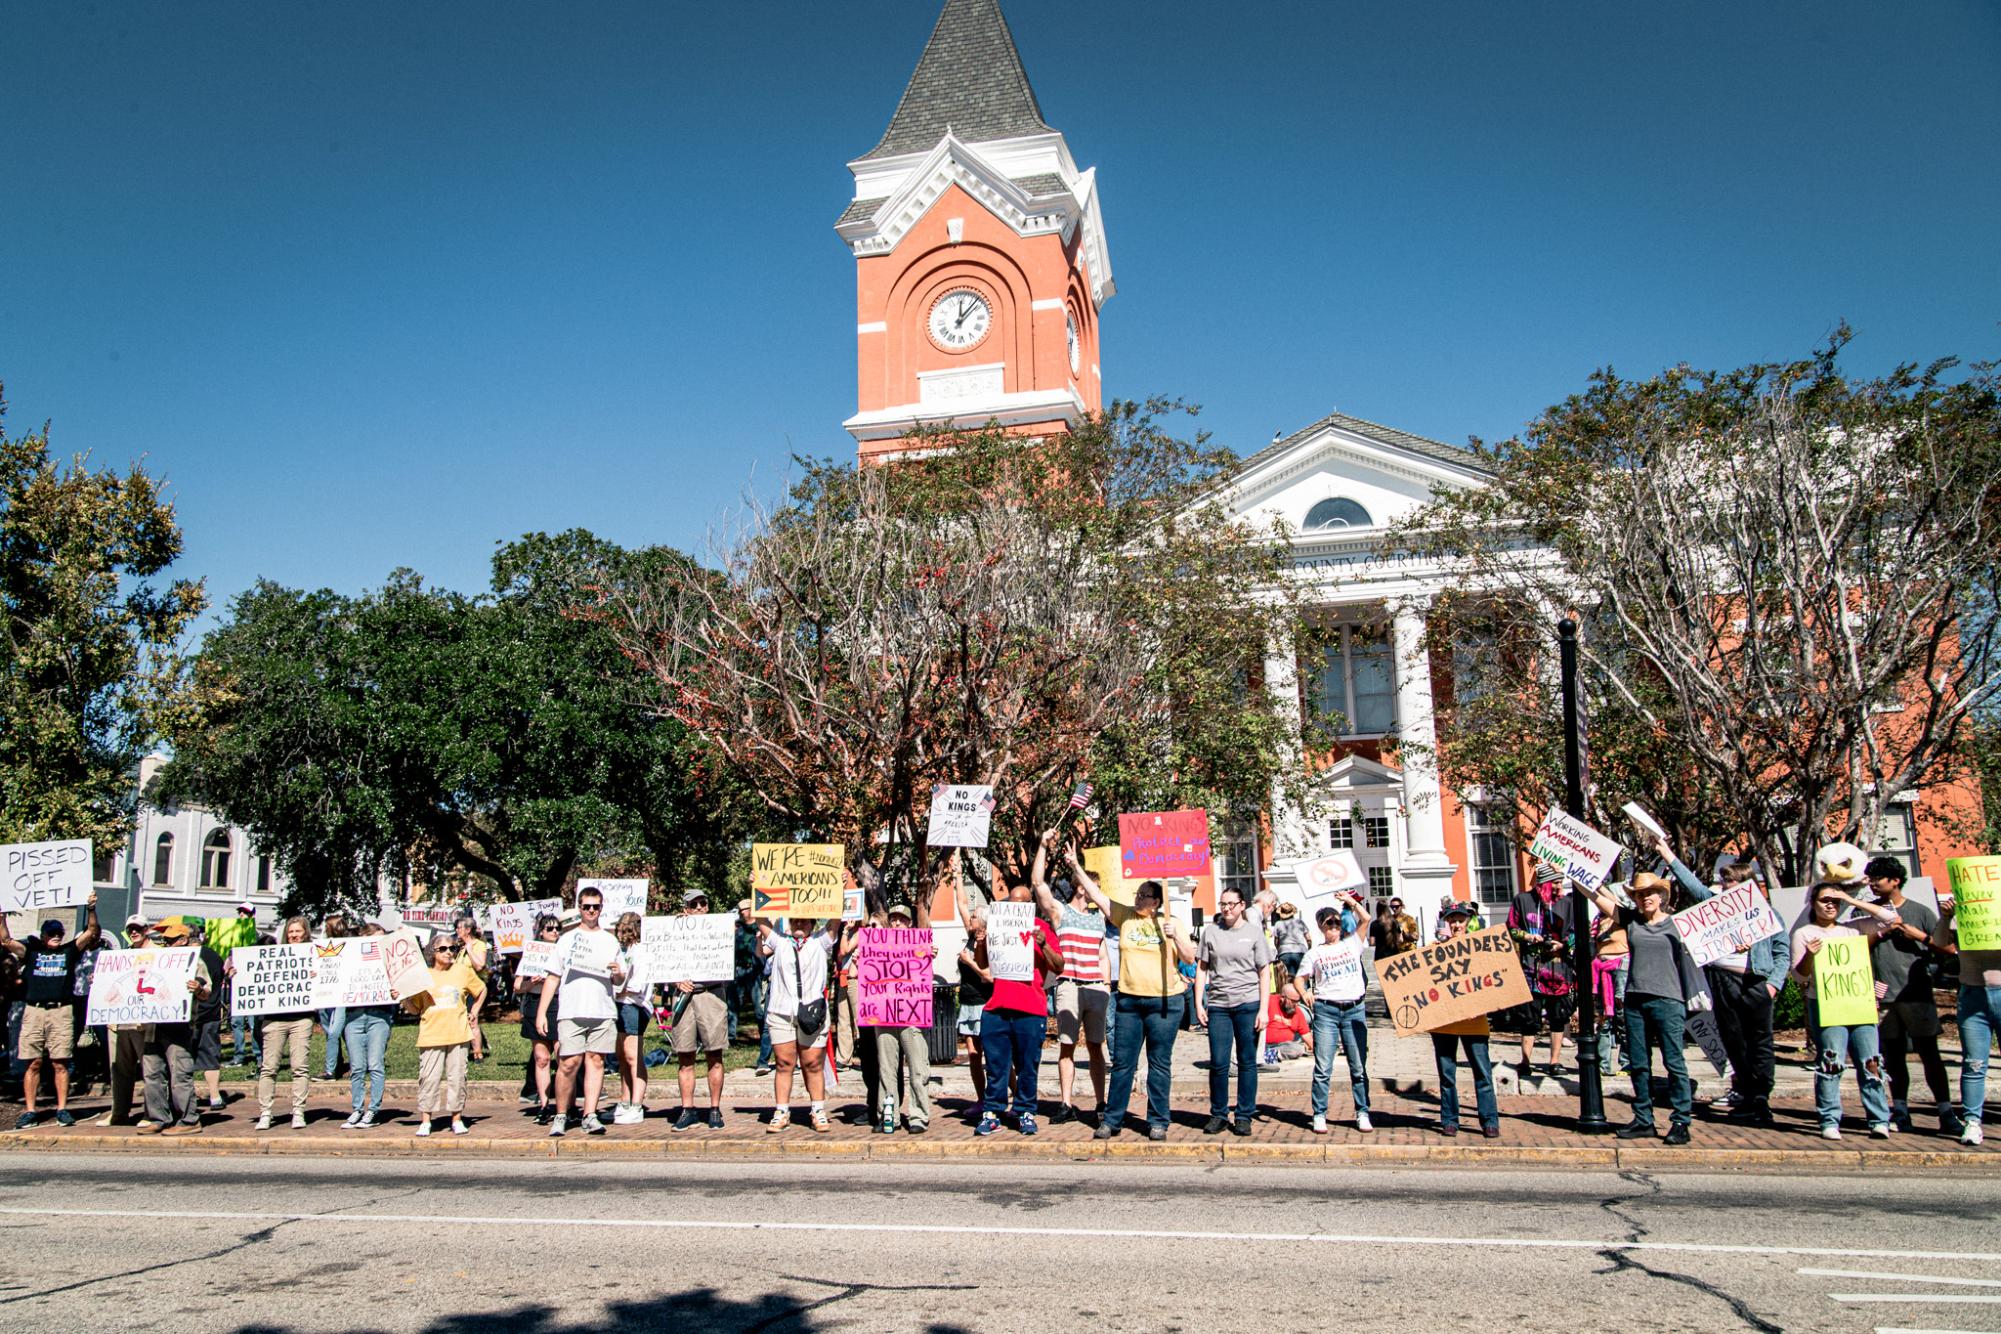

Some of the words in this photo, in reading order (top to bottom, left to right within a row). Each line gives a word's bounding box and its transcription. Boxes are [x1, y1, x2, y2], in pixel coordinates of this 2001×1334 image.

[1293, 557, 1357, 575] COUNTY
[955, 790, 968, 800] NO
[948, 802, 976, 812] KINGS
[1127, 817, 1151, 834] NO
[1166, 816, 1203, 834] KINGS
[1550, 807, 1590, 843] WORKING
[1540, 824, 1601, 863] AMERICANS
[9, 847, 87, 872] PISSED
[755, 846, 805, 870] WE'RE
[1532, 841, 1568, 868] LIVING
[1566, 862, 1599, 889] WAGE
[14, 869, 62, 891] OFF
[770, 871, 838, 886] AMERICANS
[1952, 864, 2000, 884] HATE
[14, 886, 71, 908] VET!
[790, 888, 832, 904] TOO!!!
[1955, 888, 1994, 901] Never
[500, 905, 514, 916] NO
[1674, 883, 1752, 938] DIVERSITY
[672, 917, 697, 931] NO
[1960, 918, 2001, 929] AMERI
[863, 929, 888, 944] YOU
[892, 929, 932, 944] THINK
[1693, 910, 1774, 964] STRONGER!
[1964, 932, 2001, 946] GREA
[260, 947, 296, 958] REAL
[386, 939, 408, 958] NO
[862, 946, 890, 960] they
[1384, 953, 1421, 983] THE
[1421, 930, 1513, 966] FOUNDERS
[1828, 944, 1850, 966] NO
[96, 954, 134, 972] HANDS
[158, 952, 196, 972] OFF!
[864, 956, 932, 982] STOP?
[254, 970, 308, 983] DEFEND
[1823, 966, 1872, 1002] KINGS!
[238, 982, 312, 996] DEMOCRAC
[343, 990, 389, 1003] DEMOCRAC
[895, 982, 930, 997] Rights
[128, 995, 144, 1006] OUR
[238, 998, 265, 1009] NOT
[278, 995, 310, 1007] KING
[90, 1000, 188, 1023] DEMOCRACY!
[860, 1003, 879, 1018] are
[886, 999, 931, 1025] NEXT.
